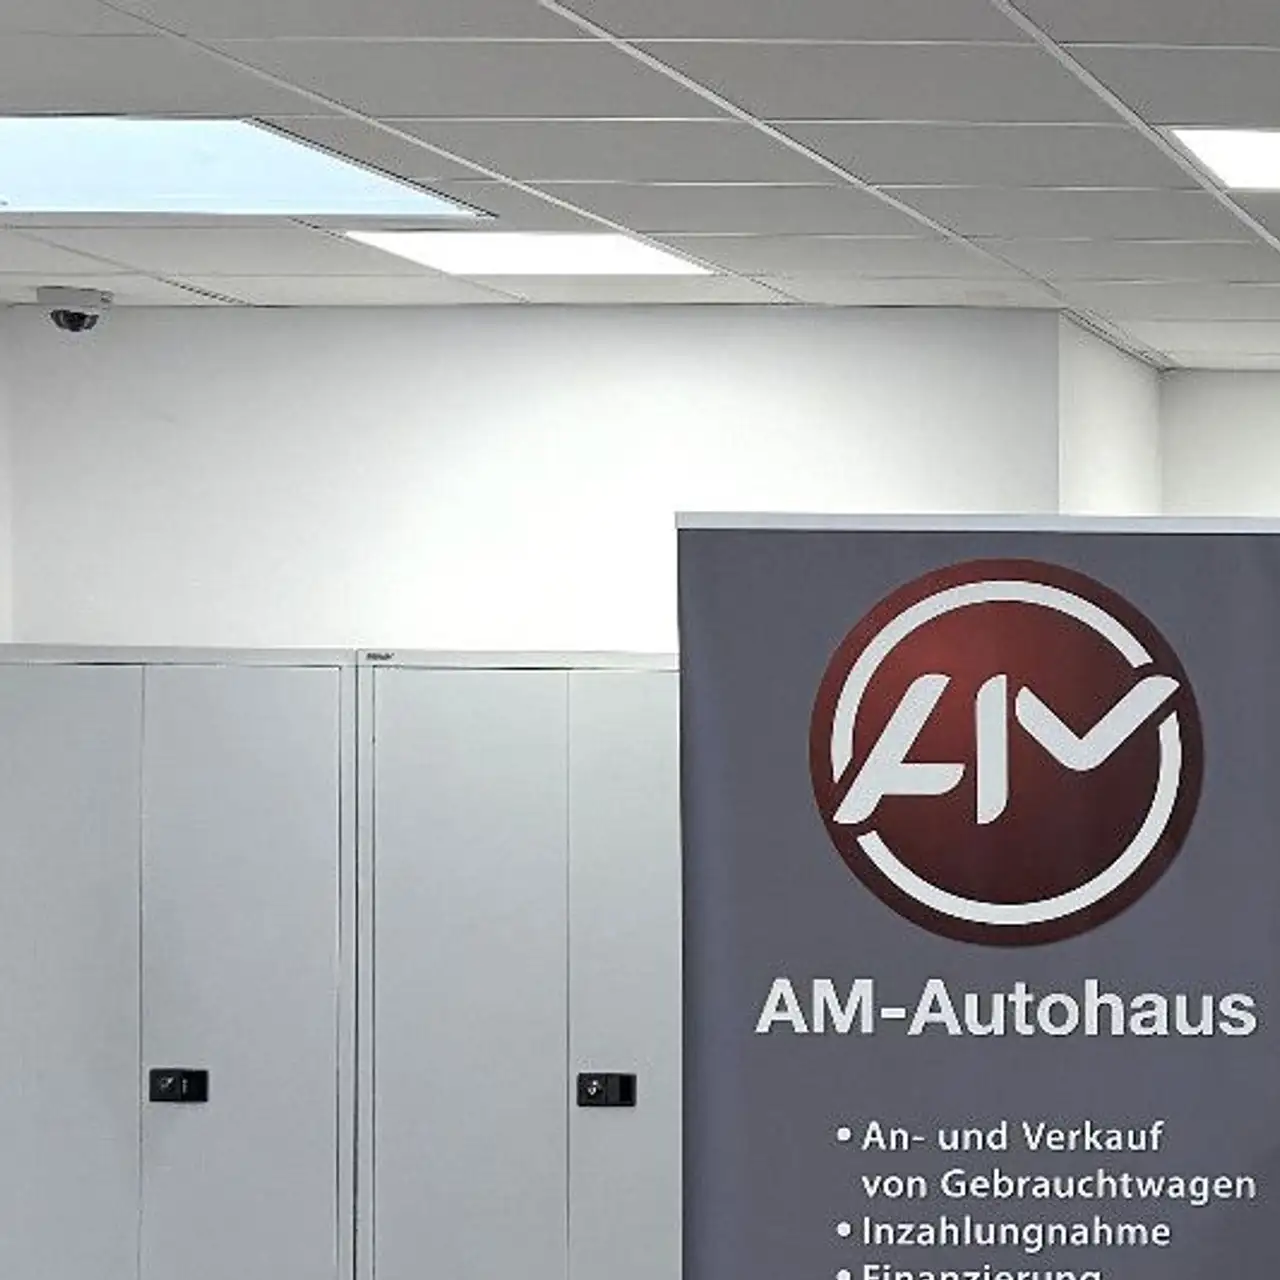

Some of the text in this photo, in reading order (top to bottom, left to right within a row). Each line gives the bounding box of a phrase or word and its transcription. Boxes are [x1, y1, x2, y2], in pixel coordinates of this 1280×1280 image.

[753, 977, 1258, 1037] AM-Autohaus
[860, 1119, 1166, 1152] An- und Verkauf
[860, 1167, 1257, 1207] von Gebrauchtwagen
[861, 1214, 1171, 1253] Inzahlungnahme
